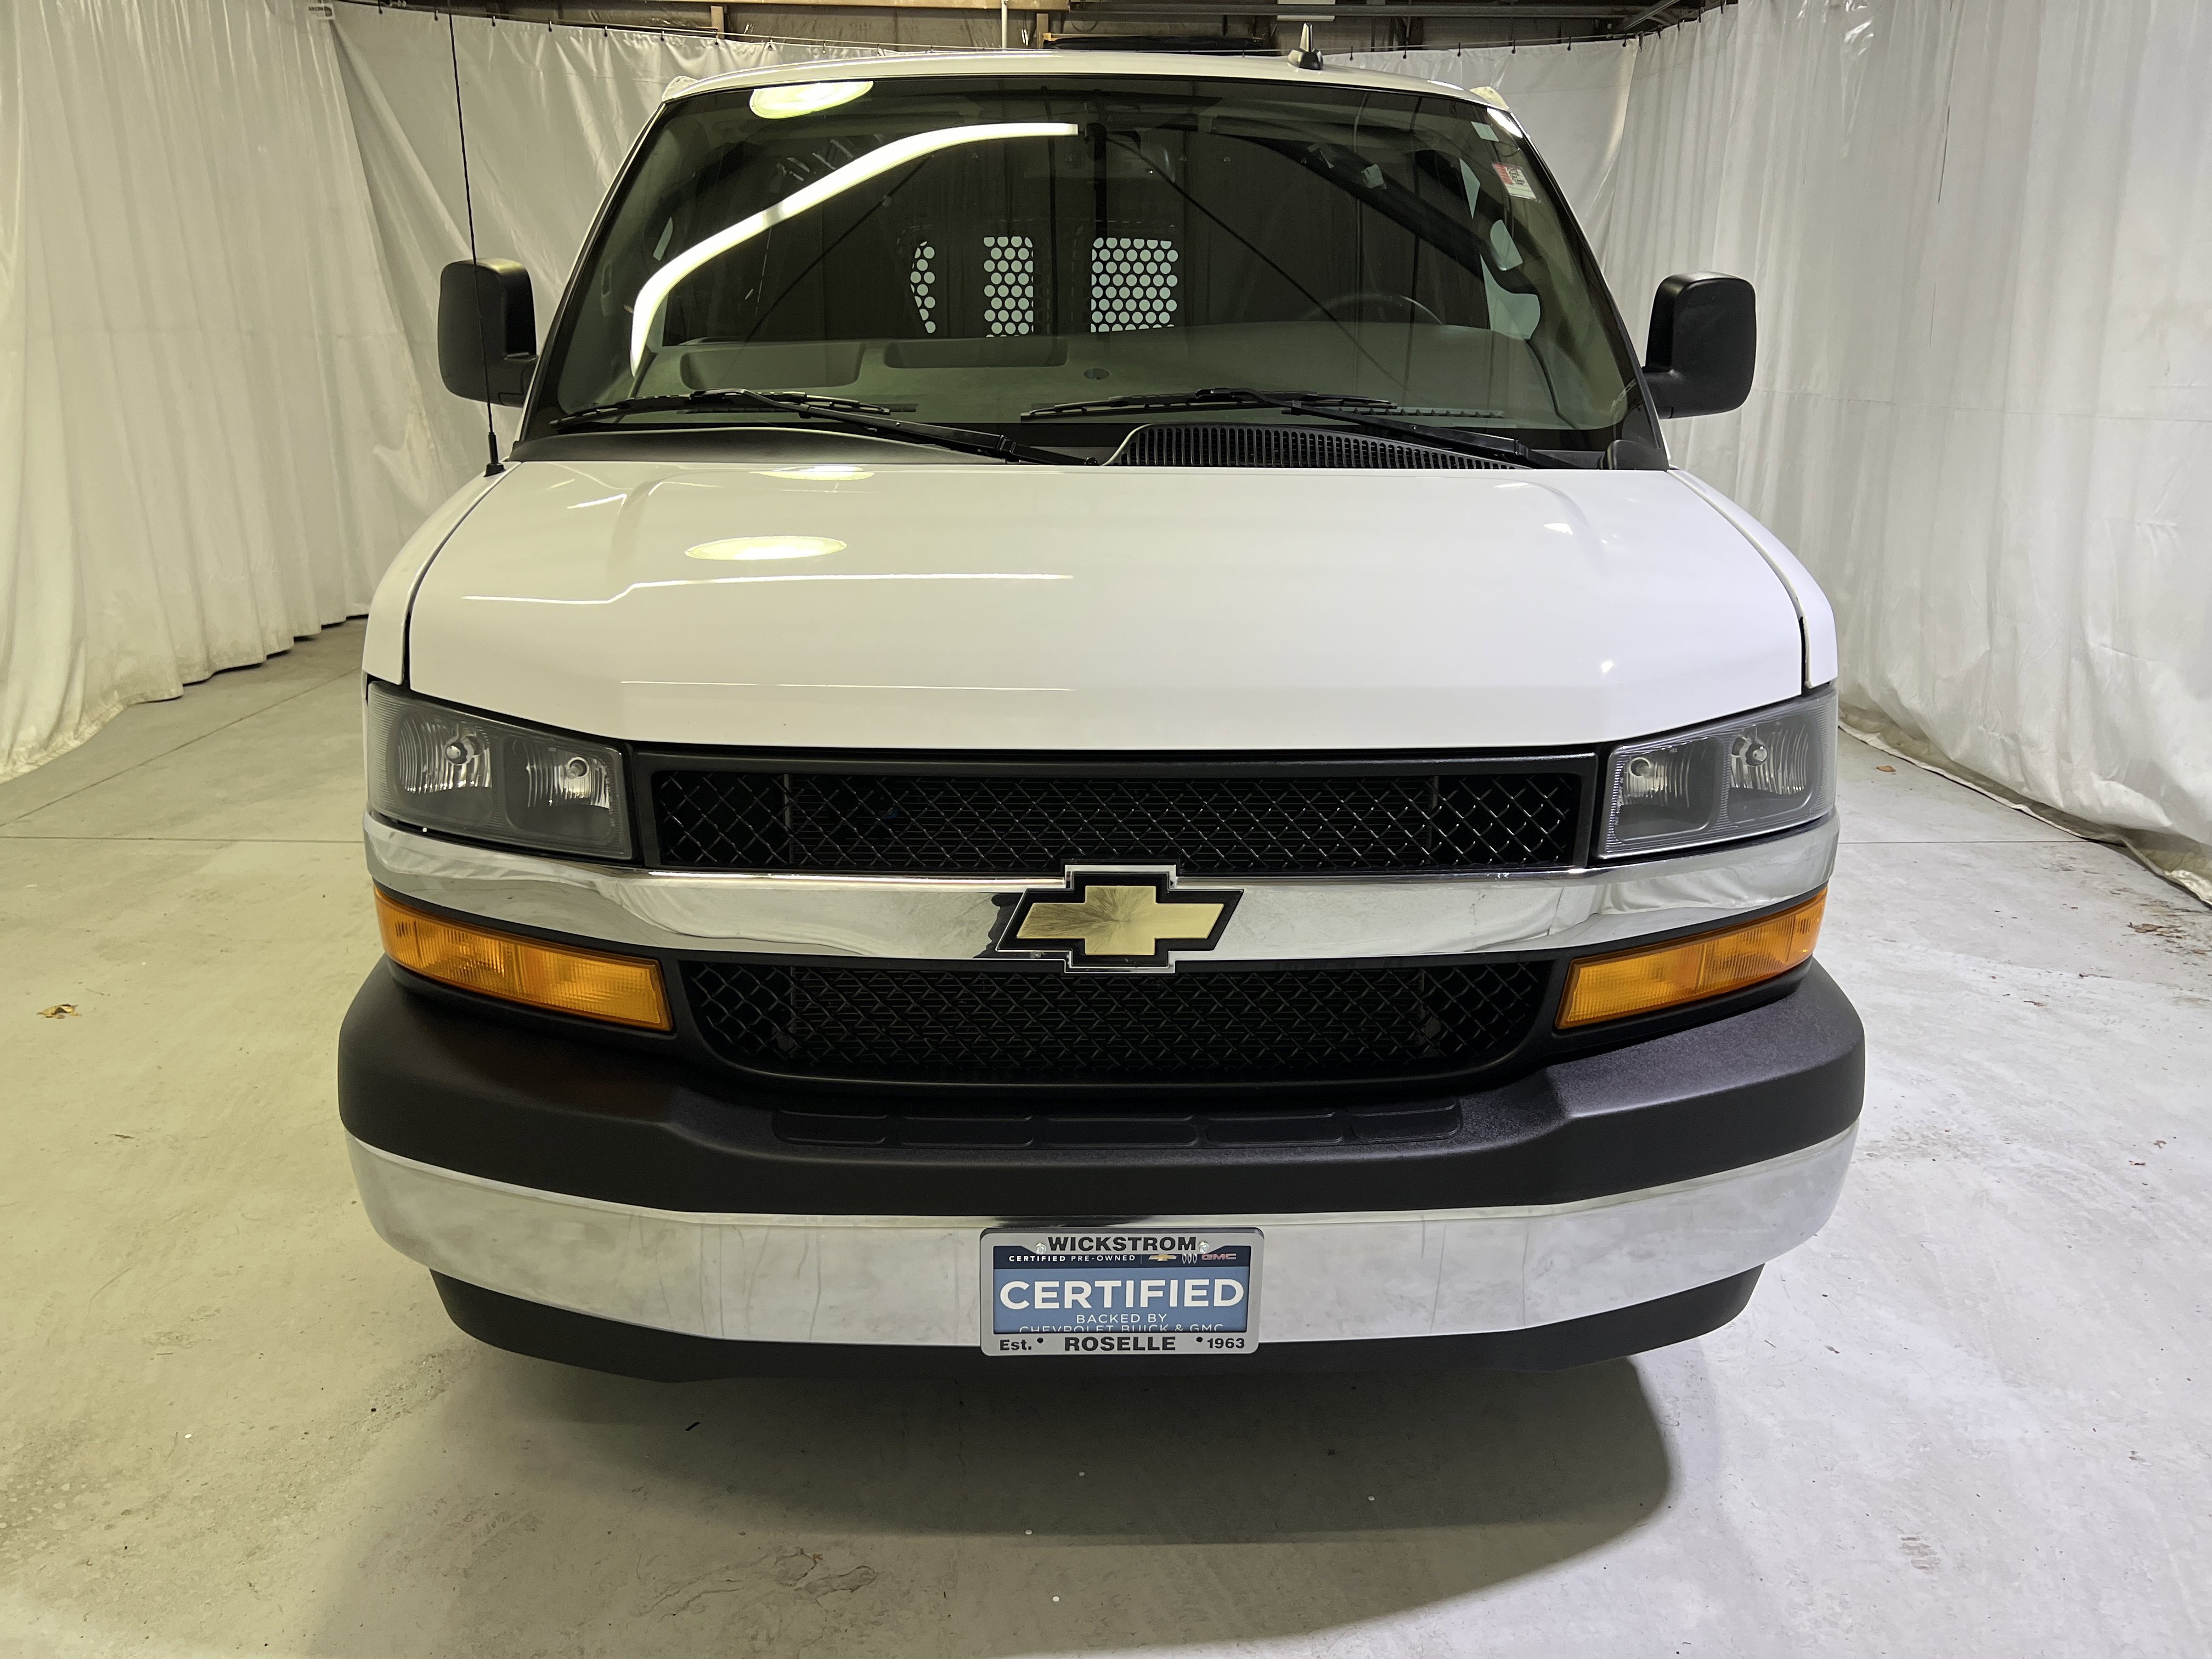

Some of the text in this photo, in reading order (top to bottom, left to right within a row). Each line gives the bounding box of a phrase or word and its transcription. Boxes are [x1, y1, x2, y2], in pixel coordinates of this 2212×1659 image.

[1047, 1237, 1197, 1251] WICKSTROM
[1201, 1252, 1237, 1261] GMC
[1000, 1279, 1244, 1310] CERTIFIED
[1076, 1313, 1167, 1324] BACKED BY
[1000, 1336, 1245, 1351] Est. ROSELLE 1963
